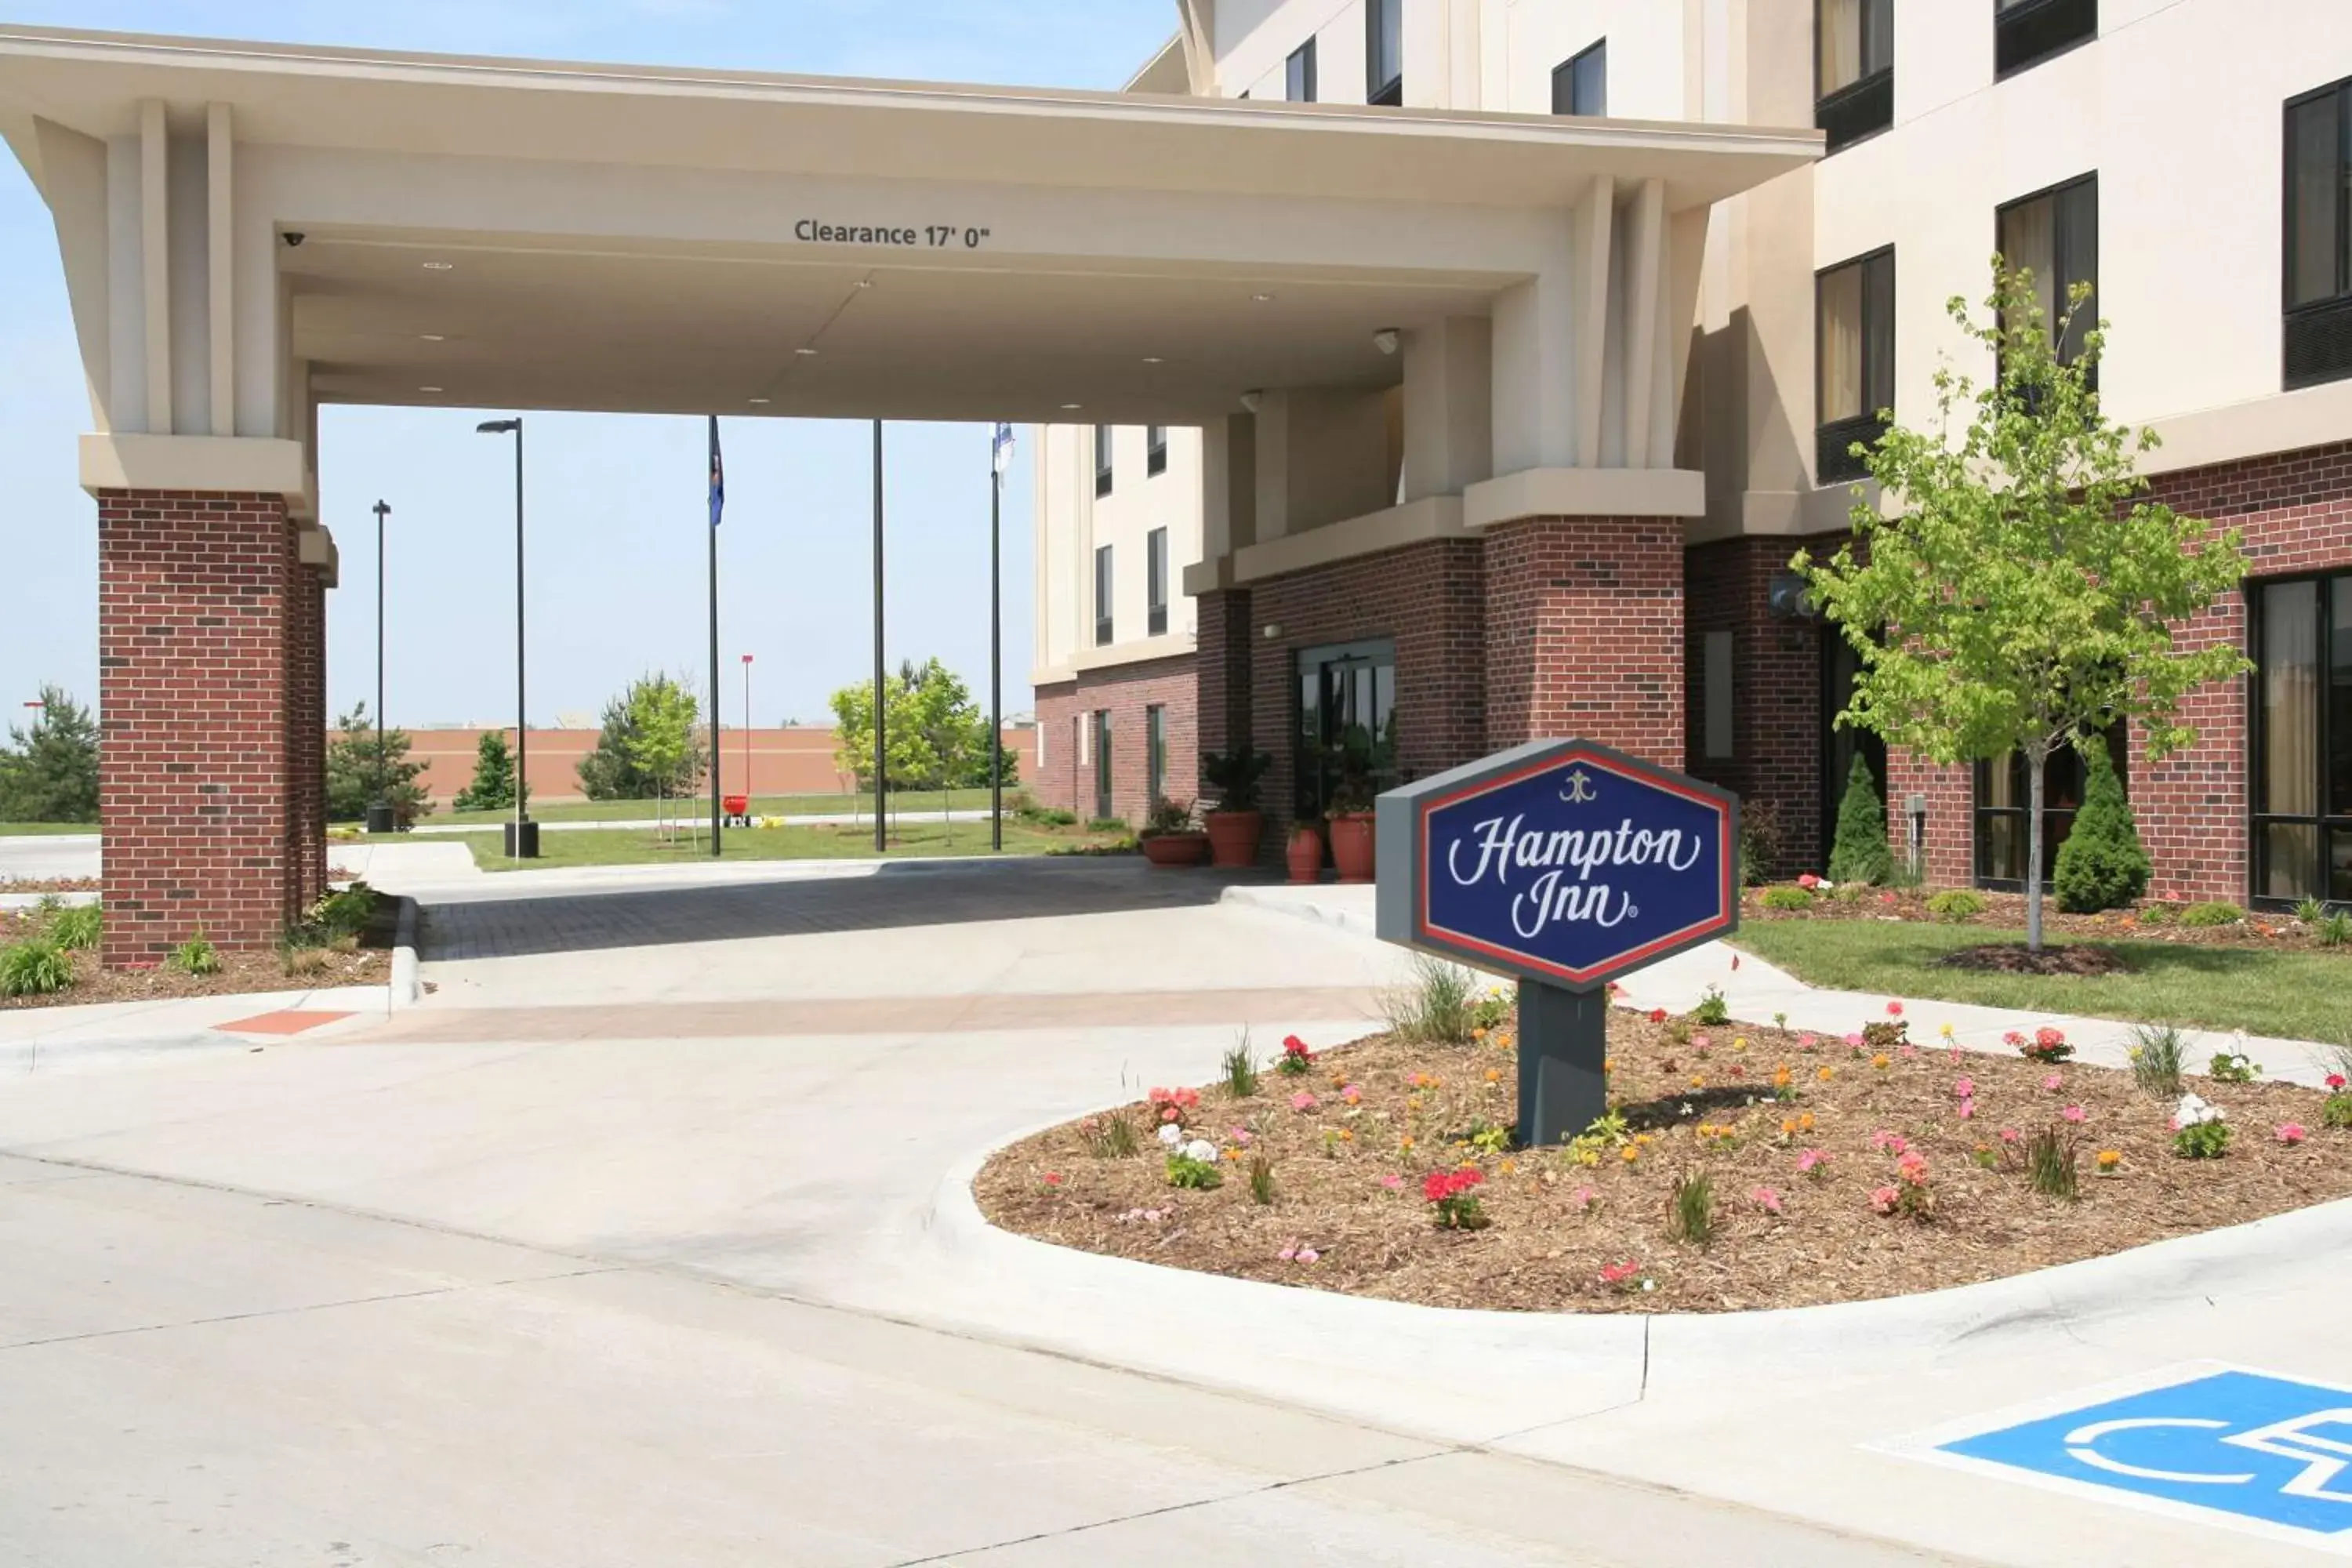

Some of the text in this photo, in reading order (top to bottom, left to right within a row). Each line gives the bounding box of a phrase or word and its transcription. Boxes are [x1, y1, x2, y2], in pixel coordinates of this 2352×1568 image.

[794, 220, 990, 249] Clearance 17' 0"
[1449, 813, 1701, 885] Hampton
